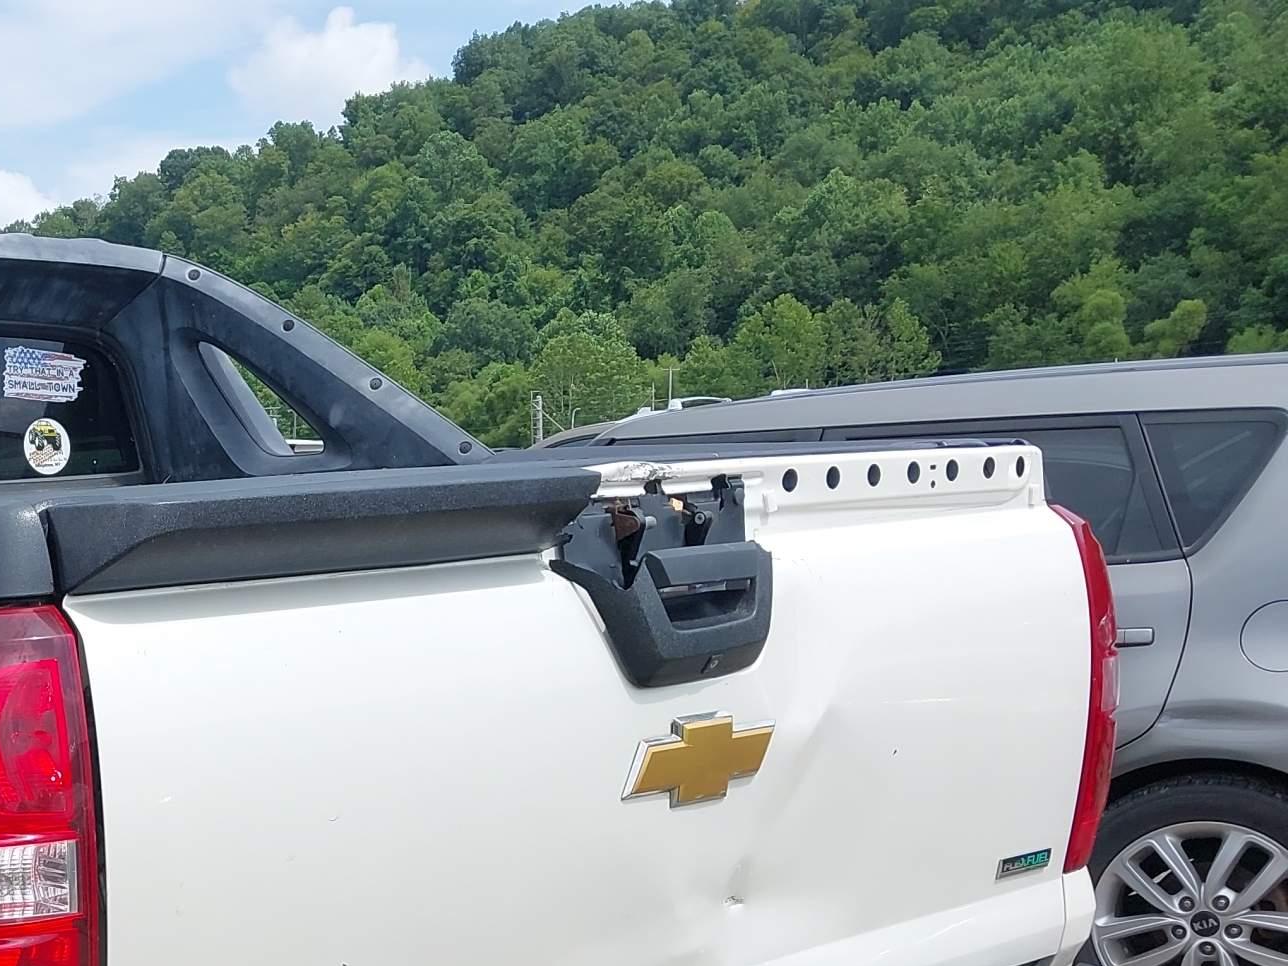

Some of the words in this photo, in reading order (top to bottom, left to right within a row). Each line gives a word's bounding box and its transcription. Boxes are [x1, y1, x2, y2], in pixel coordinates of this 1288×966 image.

[7, 364, 24, 374] TRY
[31, 367, 52, 377] THAT
[56, 368, 65, 377] IN
[7, 379, 40, 391] SMALL
[47, 382, 75, 393] TOWN
[1192, 918, 1218, 931] KIA
